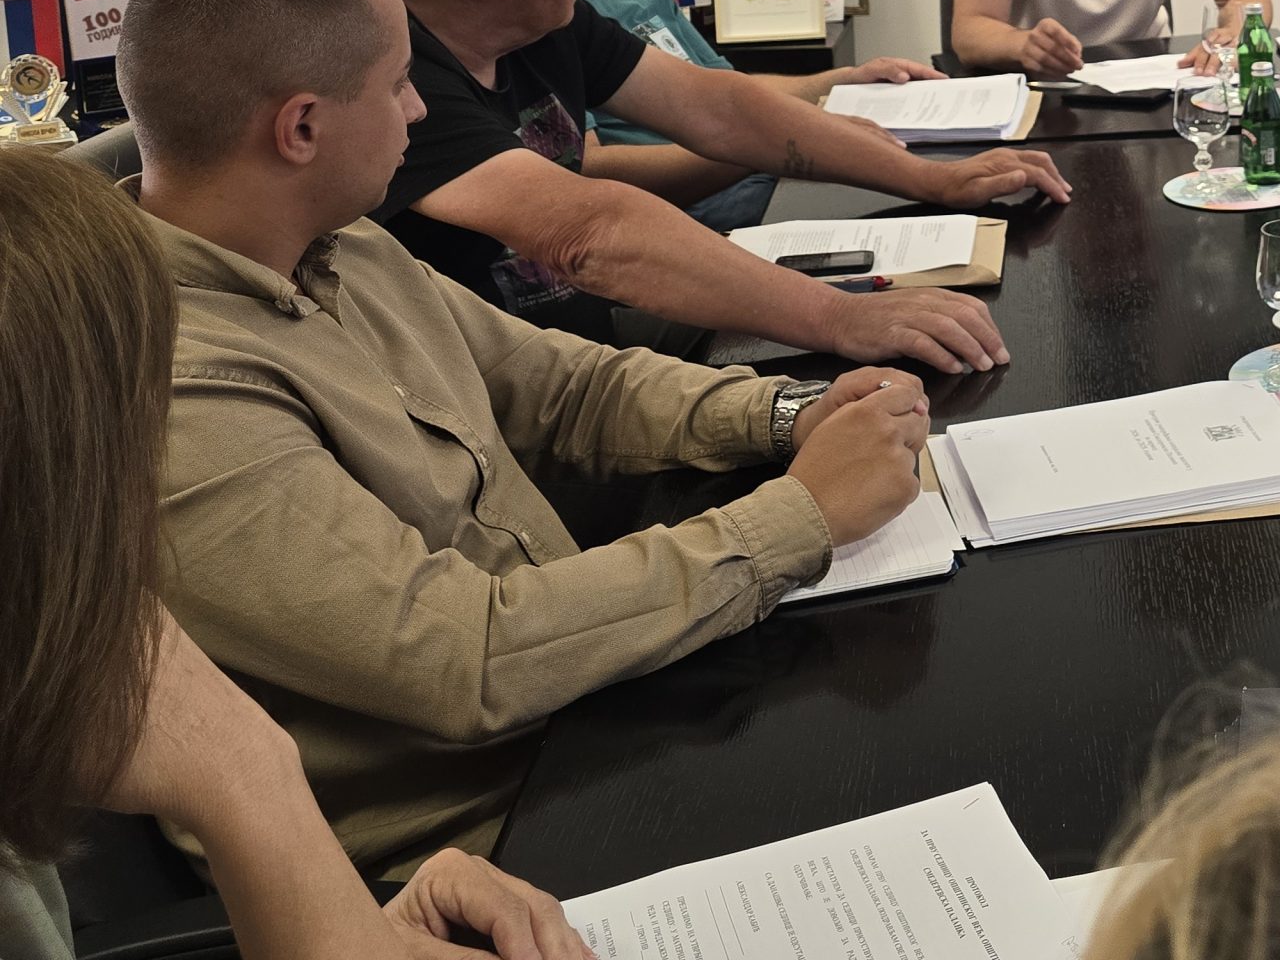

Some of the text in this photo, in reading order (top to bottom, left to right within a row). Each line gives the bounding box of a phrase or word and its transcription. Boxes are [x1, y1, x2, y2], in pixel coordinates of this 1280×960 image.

[81, 7, 122, 32] 100
[86, 24, 122, 43] ГОДИН
[919, 829, 930, 838] ЗА
[923, 837, 939, 853] ПРВУ
[931, 852, 954, 879] СЕДНИЦУ
[921, 866, 967, 939] СМЕДЕРЕВСКА ПАЛАНКА
[947, 877, 978, 921] ОПШТИНСКОГ
[964, 875, 991, 909] ПРОТОКОЛ
